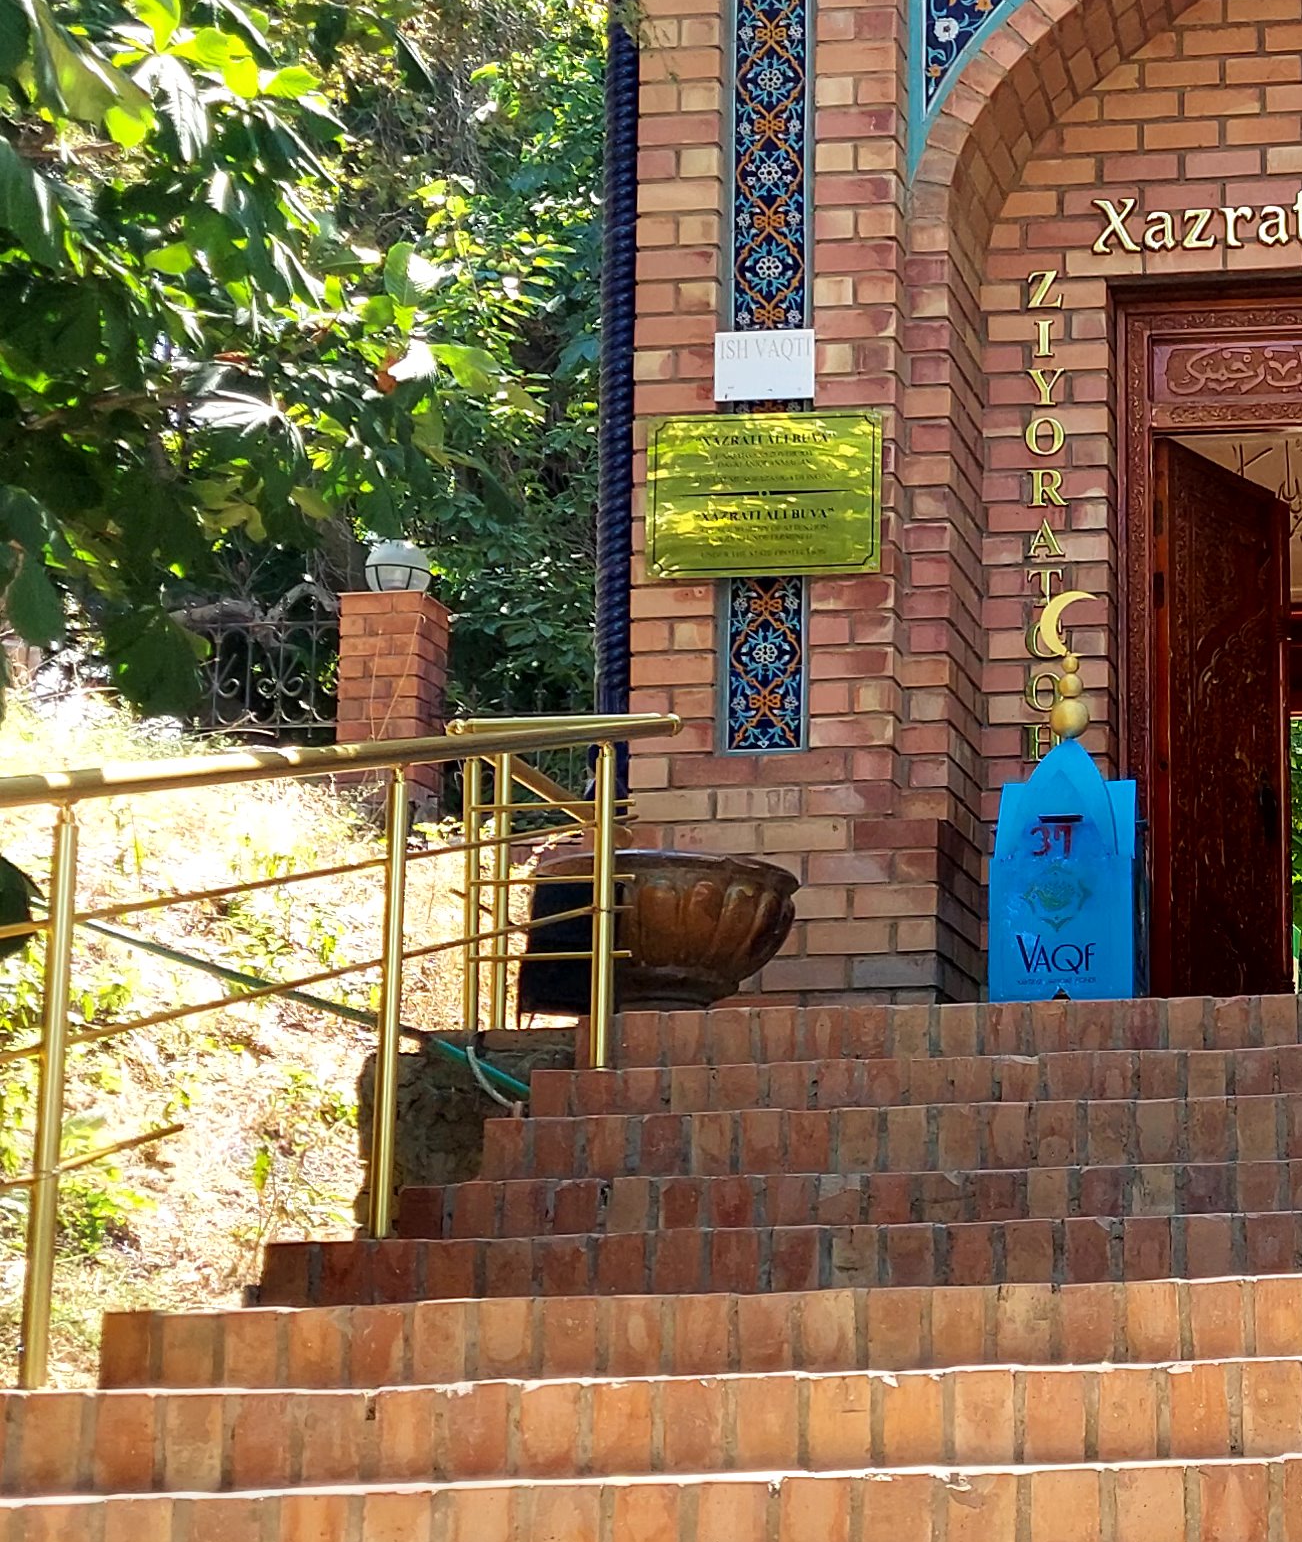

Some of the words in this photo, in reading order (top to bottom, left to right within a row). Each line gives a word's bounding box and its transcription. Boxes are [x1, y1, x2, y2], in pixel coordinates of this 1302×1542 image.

[721, 339, 748, 360] ISH
[755, 336, 811, 362] VAQTI
[1030, 822, 1074, 859] 37
[1015, 933, 1097, 975] VAQF
